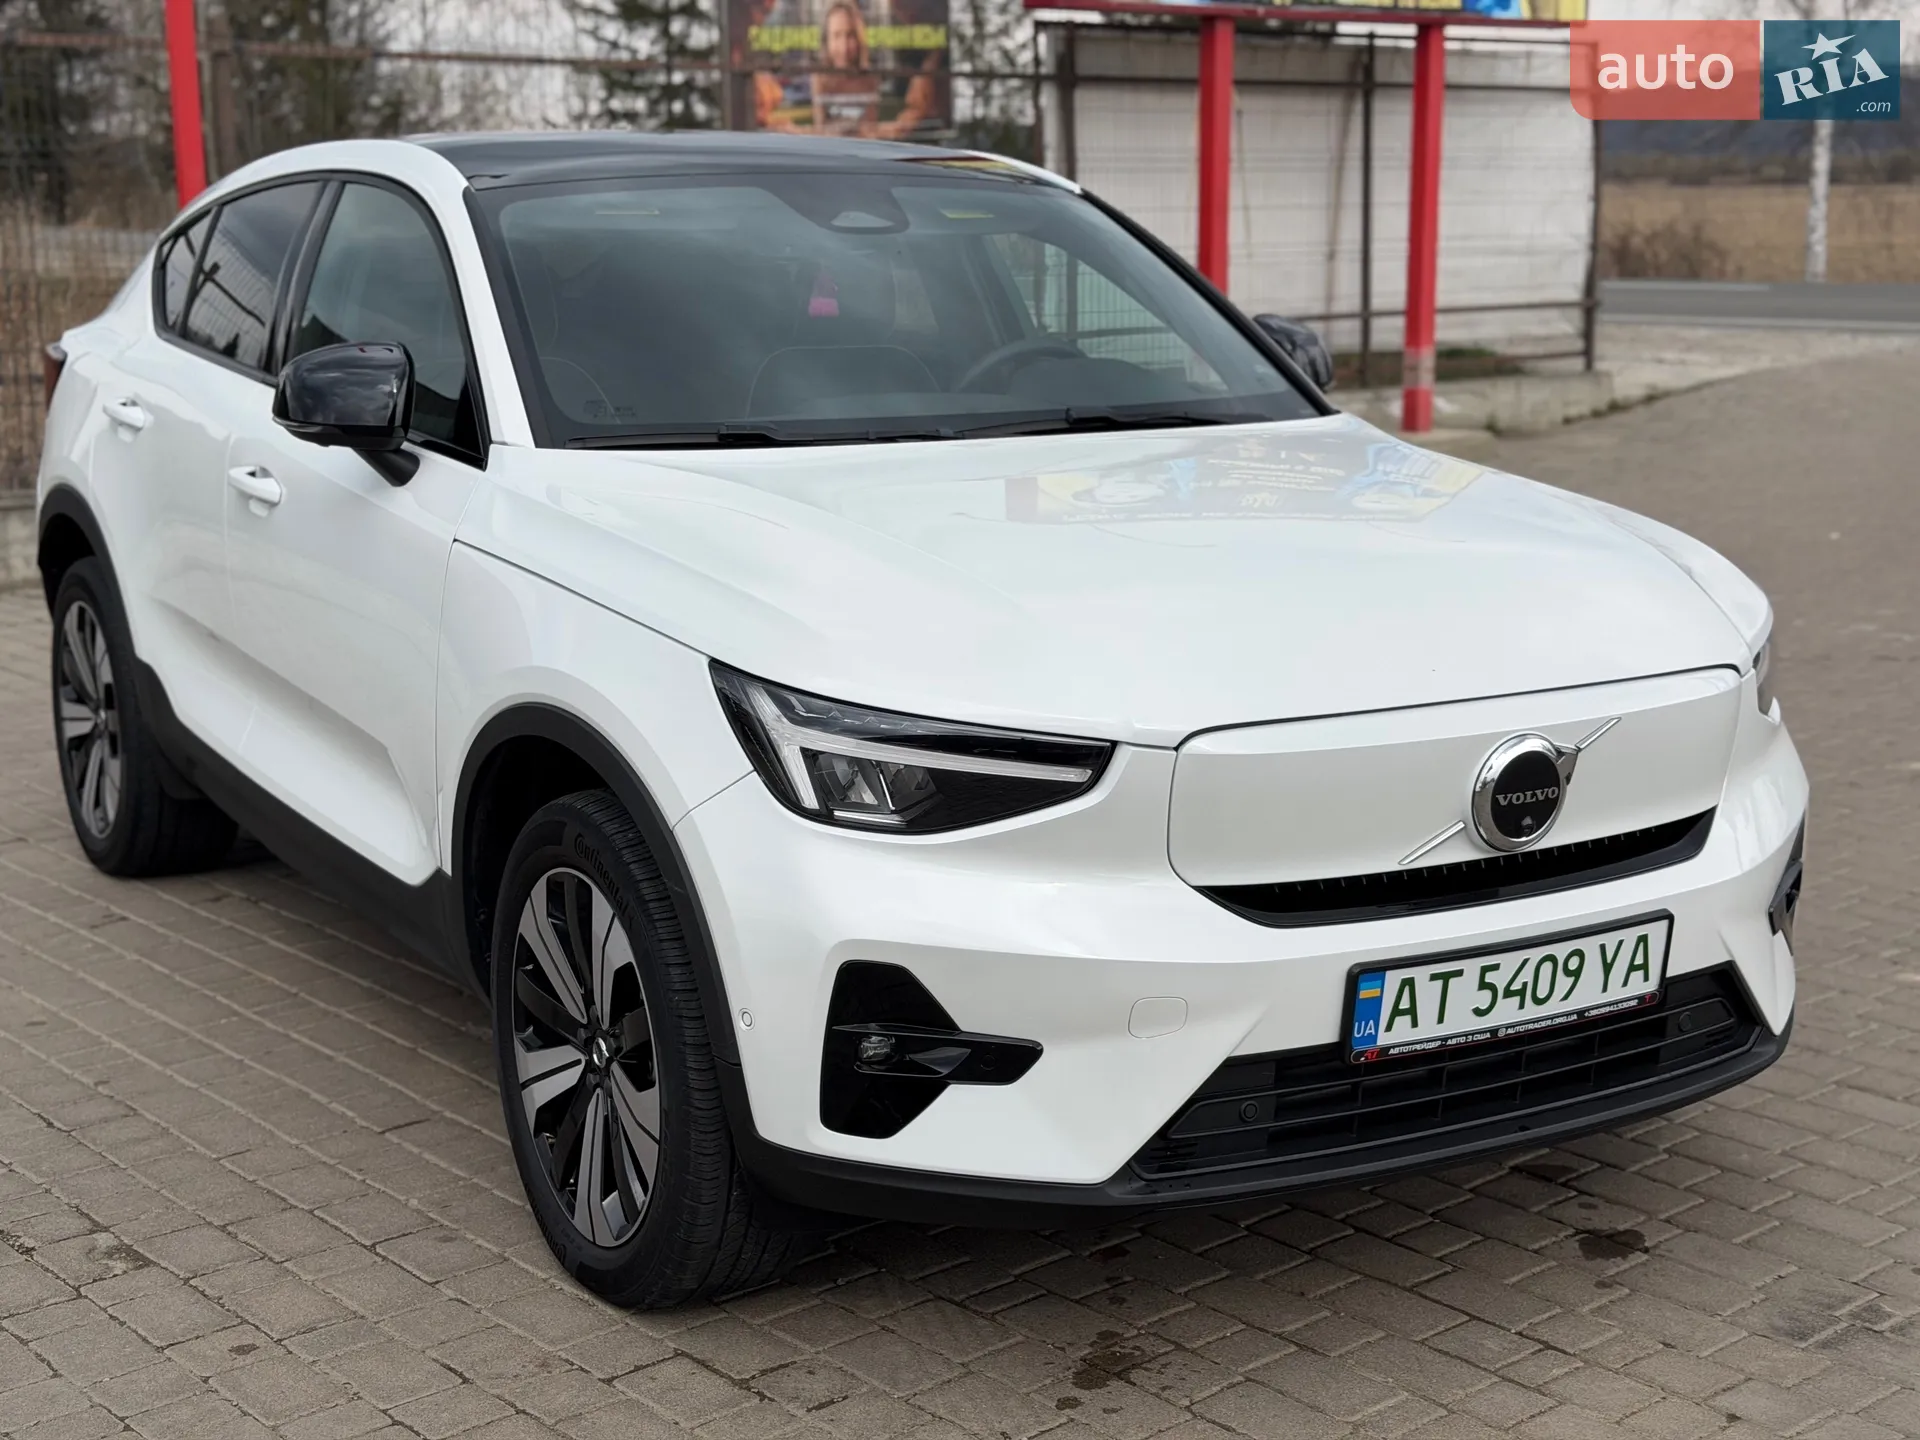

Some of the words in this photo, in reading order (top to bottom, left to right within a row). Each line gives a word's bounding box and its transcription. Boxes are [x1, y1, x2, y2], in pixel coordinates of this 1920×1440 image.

[1496, 786, 1559, 806] VOLVO
[1383, 967, 1464, 1034] AT
[1471, 947, 1586, 1018] 5409
[1599, 932, 1651, 994] YA
[1353, 1019, 1376, 1038] UA
[1446, 1036, 1466, 1046] АВТО
[1473, 1031, 1491, 1041] США
